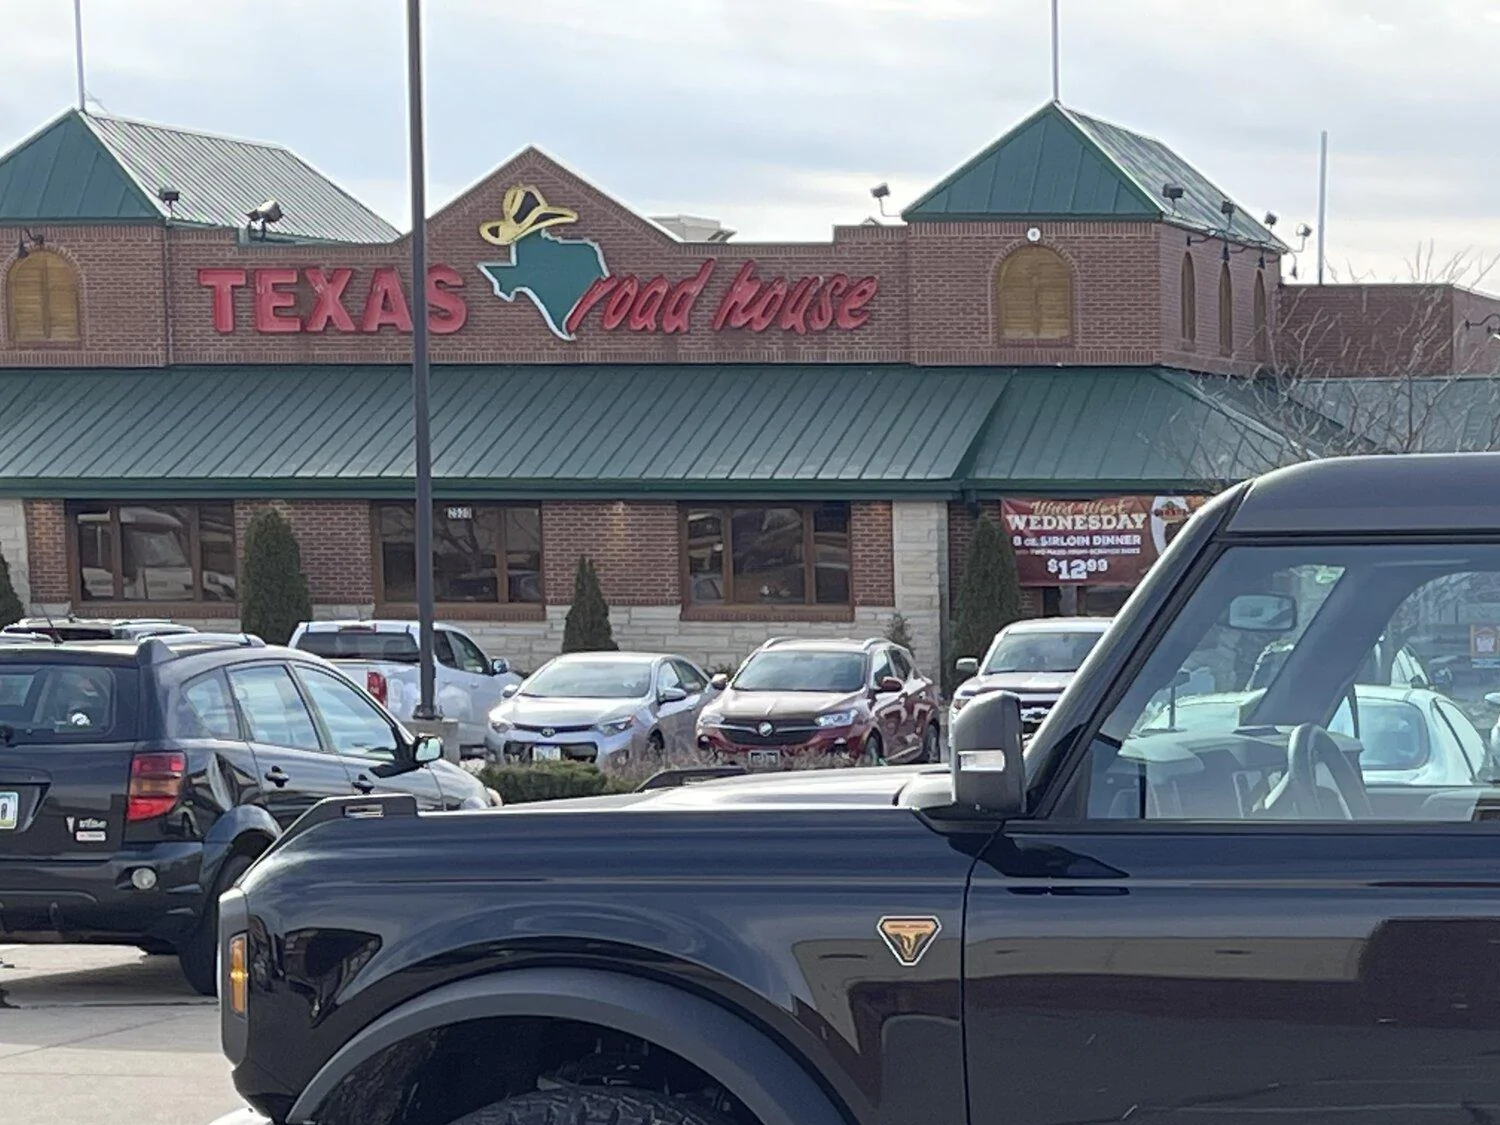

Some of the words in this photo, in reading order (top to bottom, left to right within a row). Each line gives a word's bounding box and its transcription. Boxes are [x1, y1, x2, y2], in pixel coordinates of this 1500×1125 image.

[198, 266, 468, 333] TEXAS
[565, 257, 716, 335] road
[712, 259, 879, 335] house
[1081, 499, 1128, 515] West
[1006, 513, 1148, 531] WEDNESDAY
[1040, 535, 1090, 547] SIRLOIN
[1092, 535, 1141, 546] DINNER
